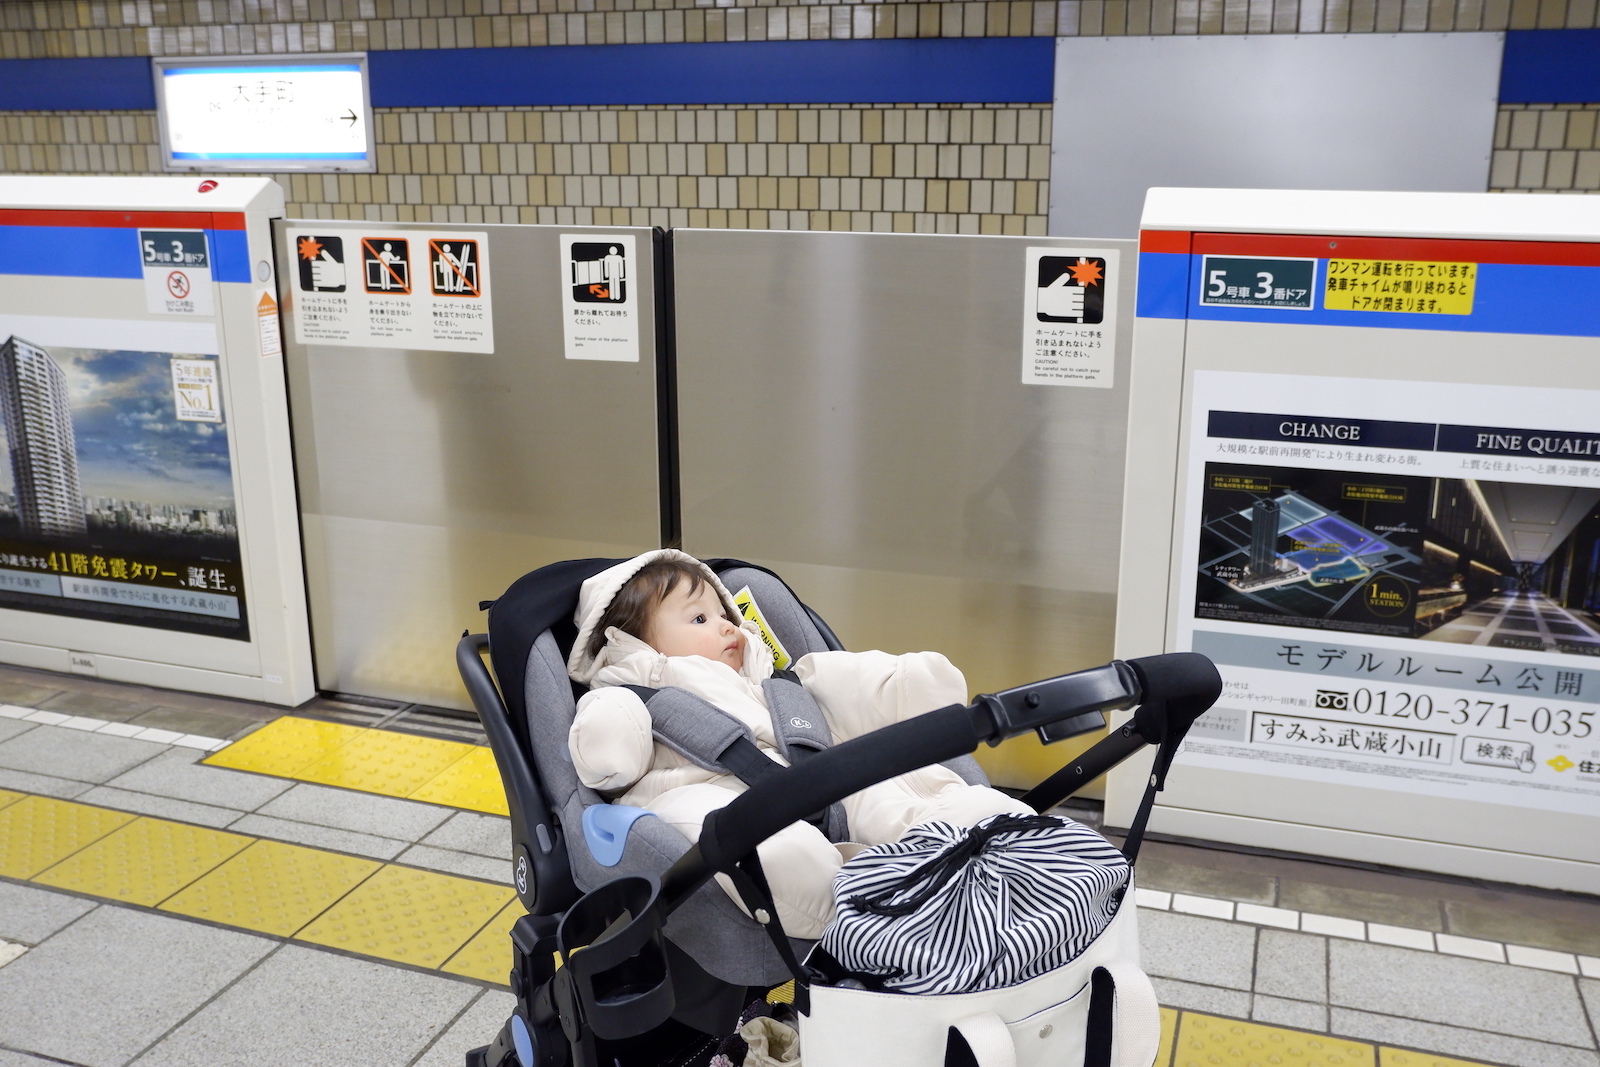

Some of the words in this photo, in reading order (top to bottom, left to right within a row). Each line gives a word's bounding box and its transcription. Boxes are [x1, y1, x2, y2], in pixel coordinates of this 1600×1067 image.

[232, 80, 293, 103] 大手町
[143, 240, 171, 262] 5号車
[171, 240, 205, 263] 3番ドア
[1329, 261, 1475, 280] ワンマン運転を行っています。
[1208, 270, 1250, 298] 5号車
[1254, 272, 1308, 301] 3番ドア
[1327, 278, 1468, 295] 発車チャイムが鳴り終わると
[432, 302, 483, 311] ホームゲートの上に
[1352, 295, 1442, 313] ドアが閉まります。
[370, 317, 399, 325] てください。
[433, 319, 458, 327] ください。
[574, 318, 601, 326] ください。
[1035, 329, 1103, 339] ホームゲートに手を
[1035, 338, 1102, 349] 引き込まれないよう
[1035, 349, 1091, 358] ご注意ください。
[178, 384, 216, 411] No.1
[1279, 421, 1361, 441] CHANGE
[1475, 433, 1523, 451] FINE
[750, 616, 781, 662] WRNING
[1276, 644, 1585, 697] モデルルーム公開
[1352, 686, 1597, 739] 0120-371-035
[1260, 718, 1443, 760] すみふ武蔵小山
[1476, 742, 1514, 760] 検索
